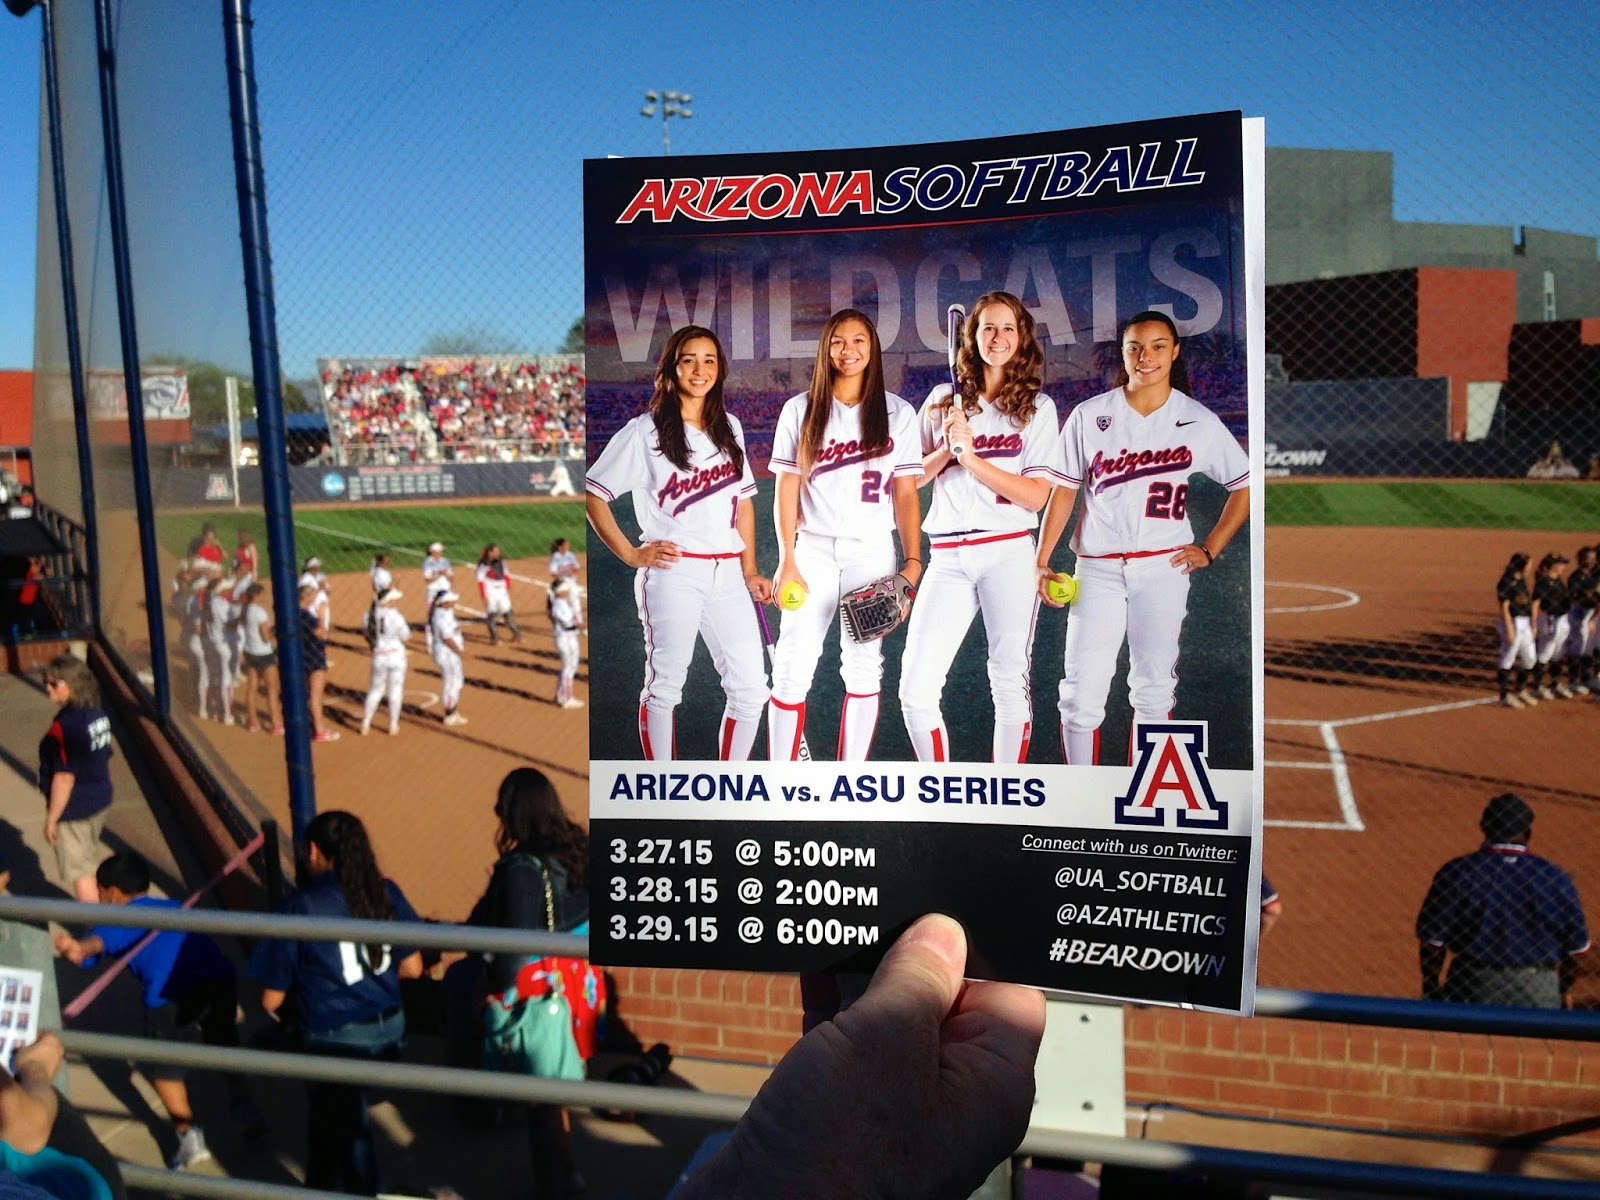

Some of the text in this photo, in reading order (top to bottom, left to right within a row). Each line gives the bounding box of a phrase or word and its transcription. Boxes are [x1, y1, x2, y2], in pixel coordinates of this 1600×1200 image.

[615, 137, 1206, 225] ARIZONA SOFTBALL
[603, 226, 1224, 364] WILDCATS
[1088, 445, 1191, 485] Arizona
[1145, 481, 1189, 521] 28
[610, 774, 1046, 807] ARIZONA vs. ASU SERIES
[1115, 724, 1228, 830] A
[610, 839, 876, 867] 3.27.15 @ 5:00PM
[1022, 834, 1238, 861] Connect with us on Twitter:
[610, 877, 878, 906] 3.28.15 @ 2:00PM
[1055, 867, 1227, 898] @UA_SOFTBALL
[610, 915, 879, 945] 3.29.15 @ 6:00PM
[1057, 903, 1226, 936] @AZATHLETICS
[1049, 938, 1225, 977] #BEARDOWN
